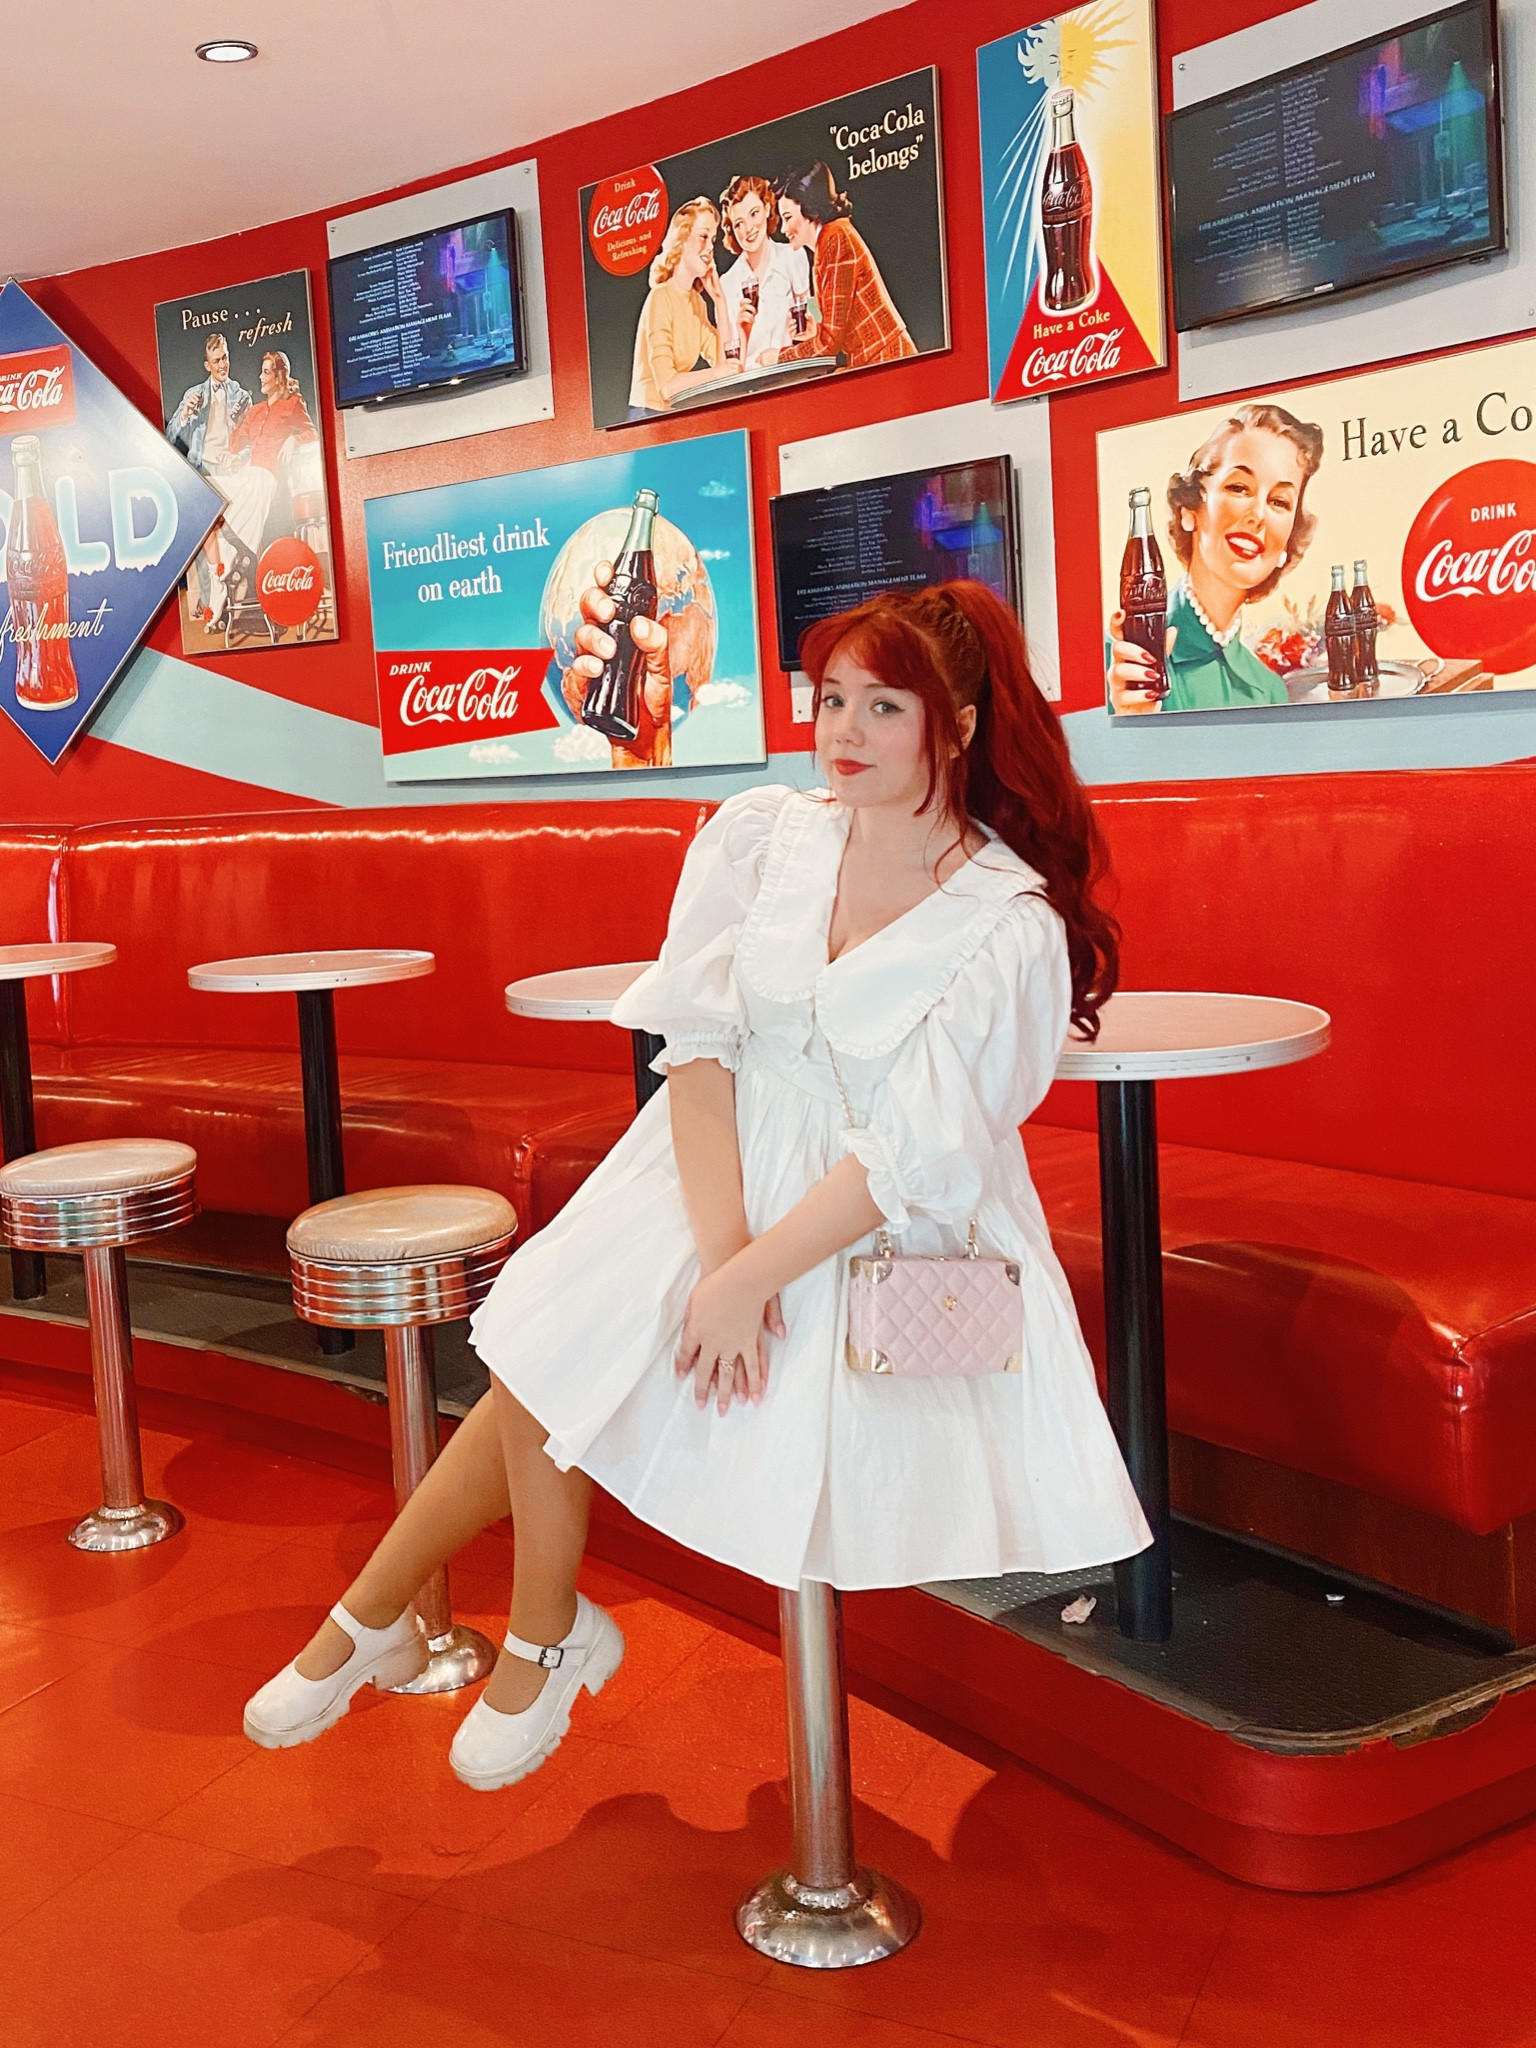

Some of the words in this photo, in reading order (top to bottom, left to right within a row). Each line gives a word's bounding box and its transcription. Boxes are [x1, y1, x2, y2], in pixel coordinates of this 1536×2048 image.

[614, 177, 637, 193] Drink
[593, 188, 661, 238] Coca-Cola
[607, 237, 637, 252] Delicious
[638, 229, 652, 242] and
[612, 245, 648, 262] Refreshing
[238, 311, 293, 346] refresh
[1033, 323, 1063, 340] Have
[1066, 320, 1075, 331] a
[1078, 309, 1111, 328] Coke
[1021, 326, 1126, 388] Coca-Cola
[0, 372, 23, 382] RINK
[1341, 416, 1427, 462] Have
[1442, 418, 1463, 444] a
[1470, 502, 1517, 523] DRINK
[382, 531, 488, 570] Friendliest
[492, 517, 551, 554] drink
[261, 564, 315, 595] Coca-Cola
[418, 581, 444, 603] on
[448, 565, 503, 599] earth
[389, 660, 432, 676] DRINK
[399, 665, 522, 727] Coca-Cola
